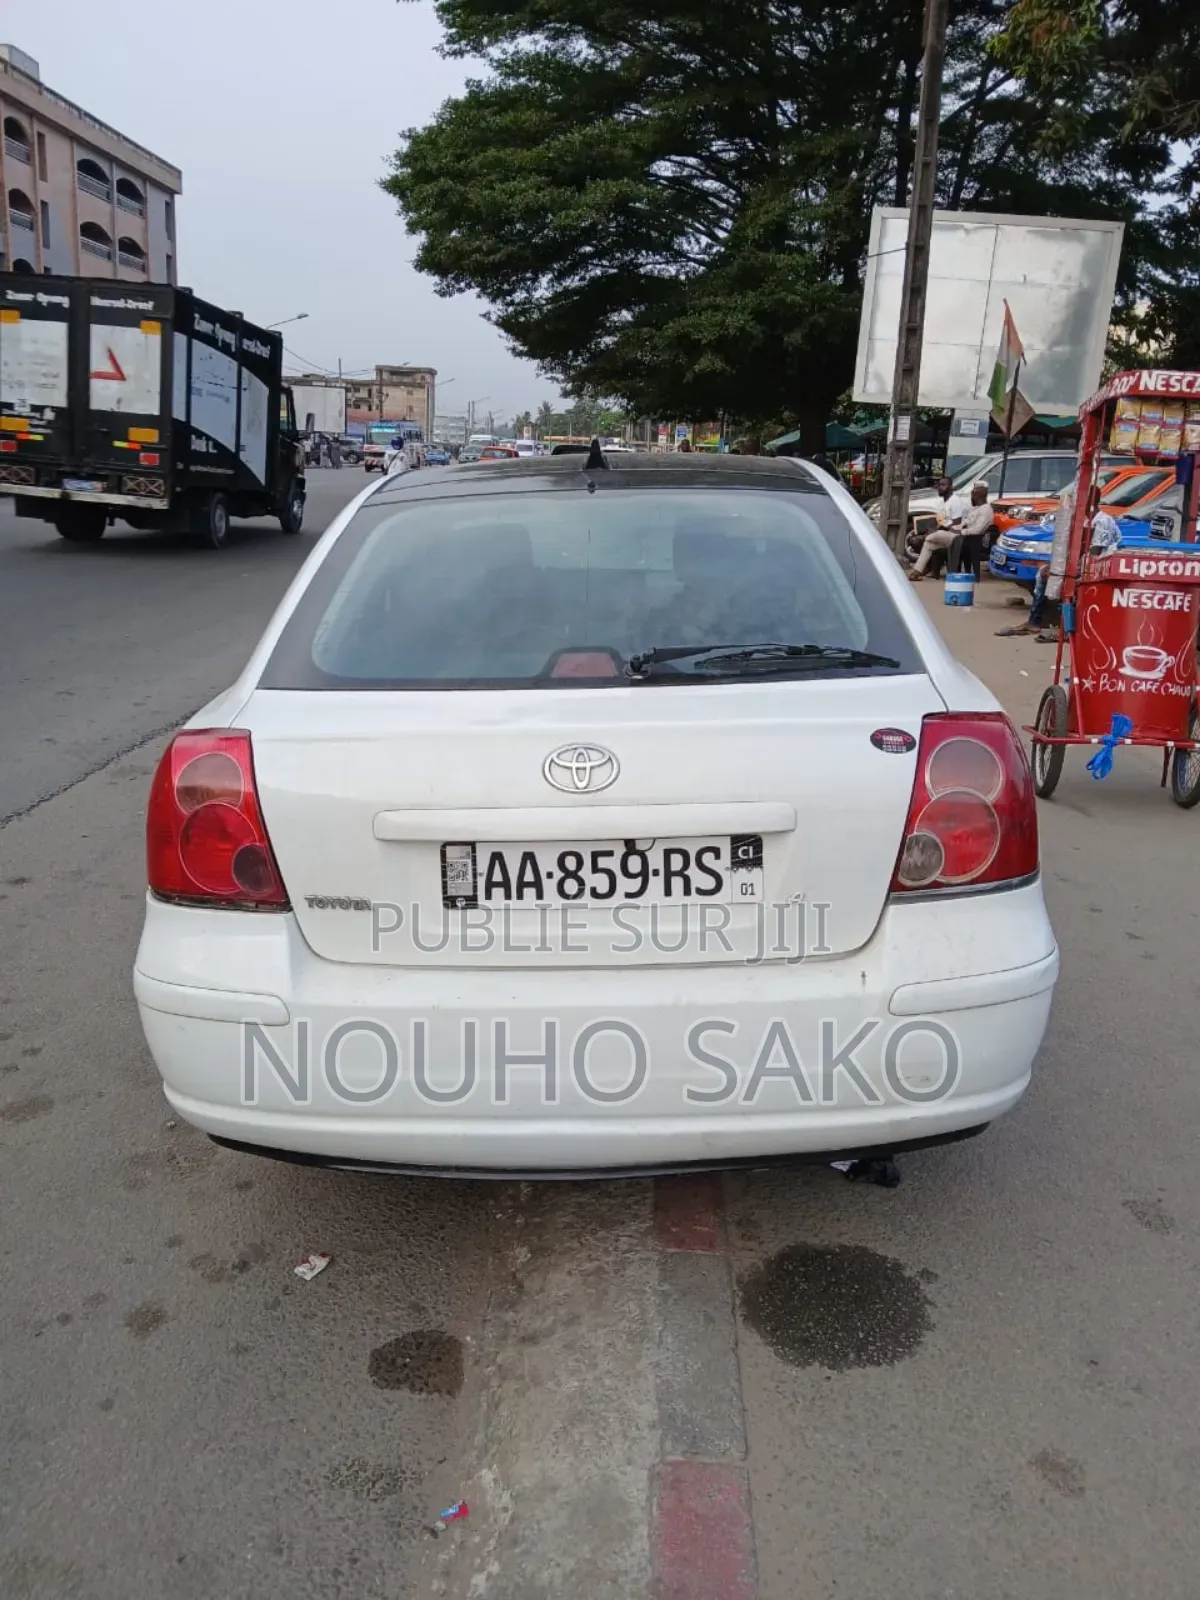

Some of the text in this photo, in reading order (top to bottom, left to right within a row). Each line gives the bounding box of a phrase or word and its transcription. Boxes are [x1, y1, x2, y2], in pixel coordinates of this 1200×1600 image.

[1119, 558, 1200, 578] Lipton
[1099, 673, 1126, 692] BON
[738, 845, 754, 859] CI
[740, 882, 756, 896] 01
[303, 895, 372, 911] TOYOTA
